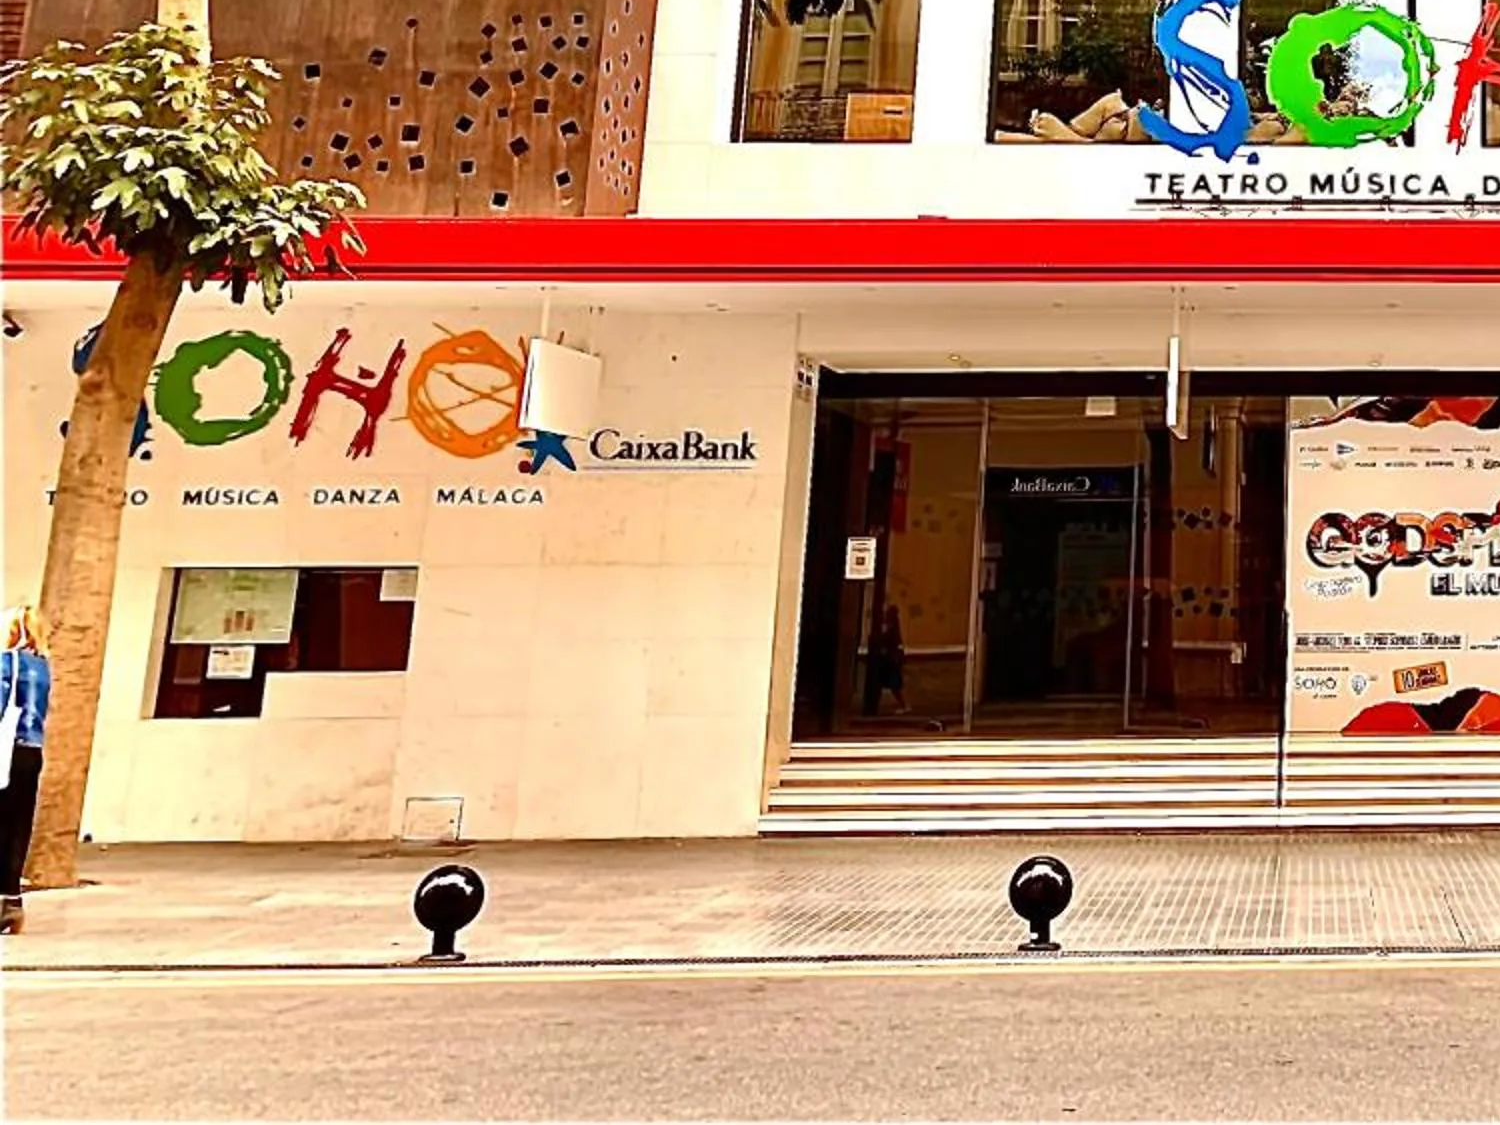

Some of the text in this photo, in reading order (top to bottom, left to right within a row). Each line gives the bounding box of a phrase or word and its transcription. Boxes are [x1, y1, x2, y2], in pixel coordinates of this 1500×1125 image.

[1144, 173, 1288, 195] TEATRO
[1309, 166, 1450, 196] MÚSICA
[589, 428, 756, 461] CaixaBank
[182, 486, 544, 506] MÚSICA DANZA MÁLAGA
[1431, 572, 1463, 596] EL
